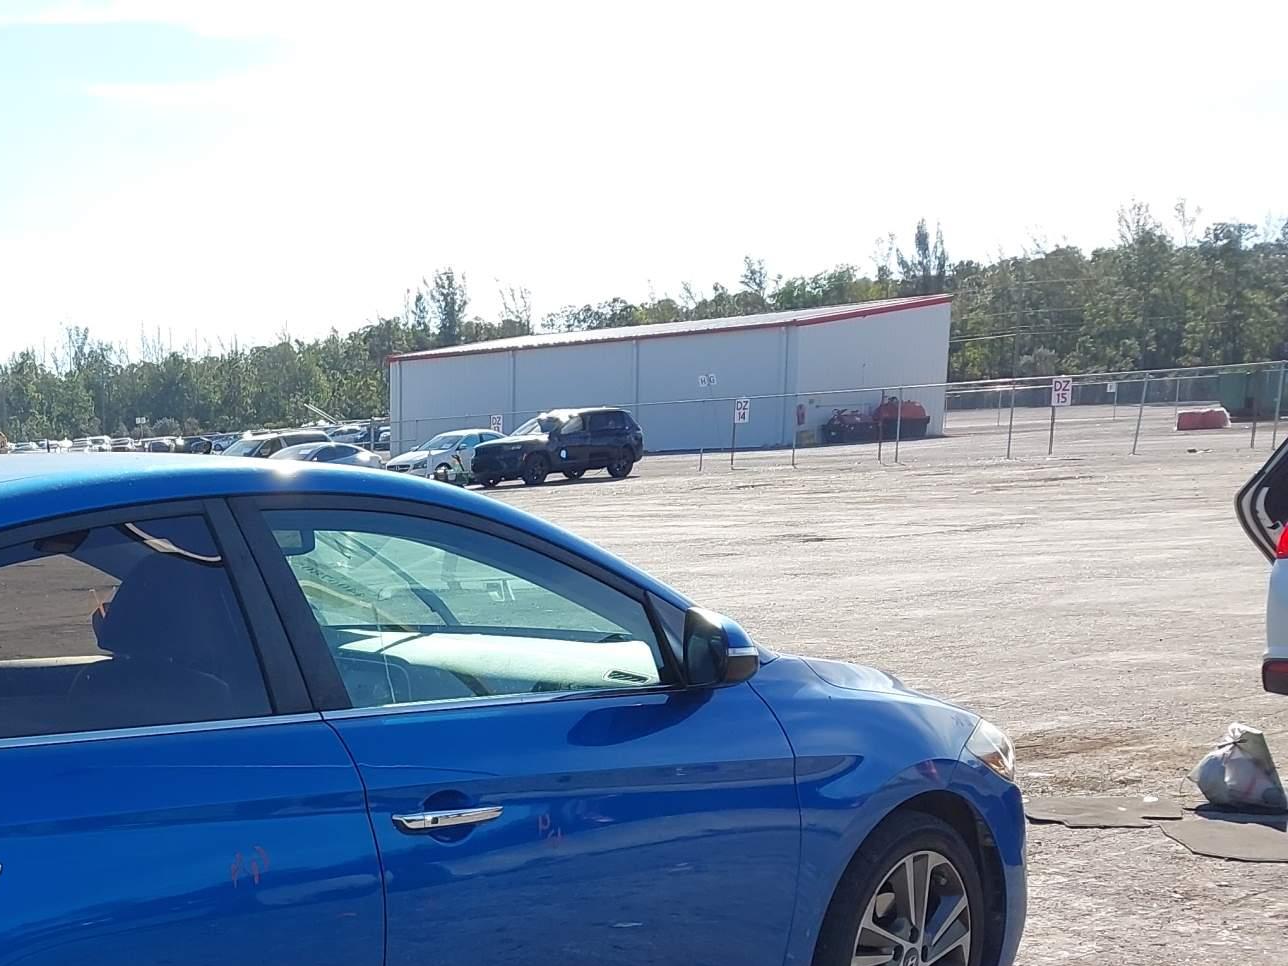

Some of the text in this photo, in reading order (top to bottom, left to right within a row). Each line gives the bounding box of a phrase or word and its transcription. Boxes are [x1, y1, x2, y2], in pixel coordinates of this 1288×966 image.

[1054, 380, 1071, 392] DZ
[1056, 392, 1067, 404] 15
[736, 400, 749, 411] DZ
[492, 416, 501, 425] DZ
[738, 411, 746, 421] 14
